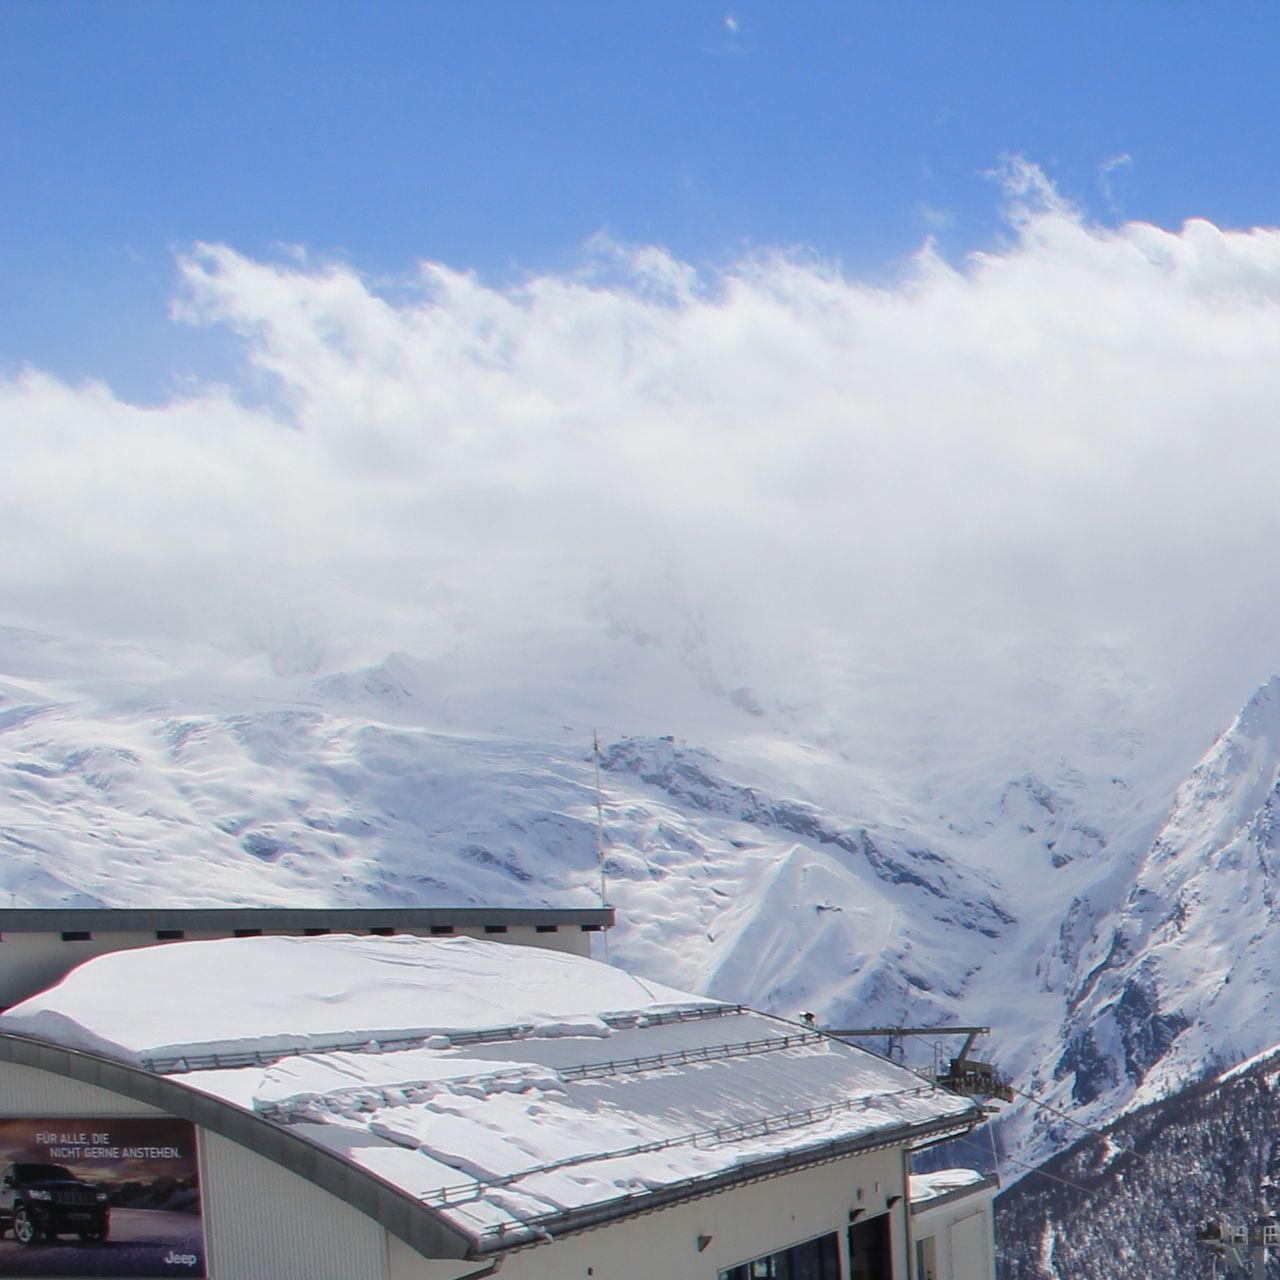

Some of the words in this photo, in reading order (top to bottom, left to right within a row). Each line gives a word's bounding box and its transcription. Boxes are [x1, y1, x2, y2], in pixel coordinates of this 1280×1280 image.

[36, 1131, 57, 1144] FÜR
[60, 1133, 90, 1145] ALLE,
[92, 1133, 110, 1145] DIE
[50, 1147, 81, 1158] NICHT
[84, 1147, 119, 1158] GERNE
[122, 1147, 182, 1159] ANSTEHEN.
[164, 1251, 197, 1266] Jeep
